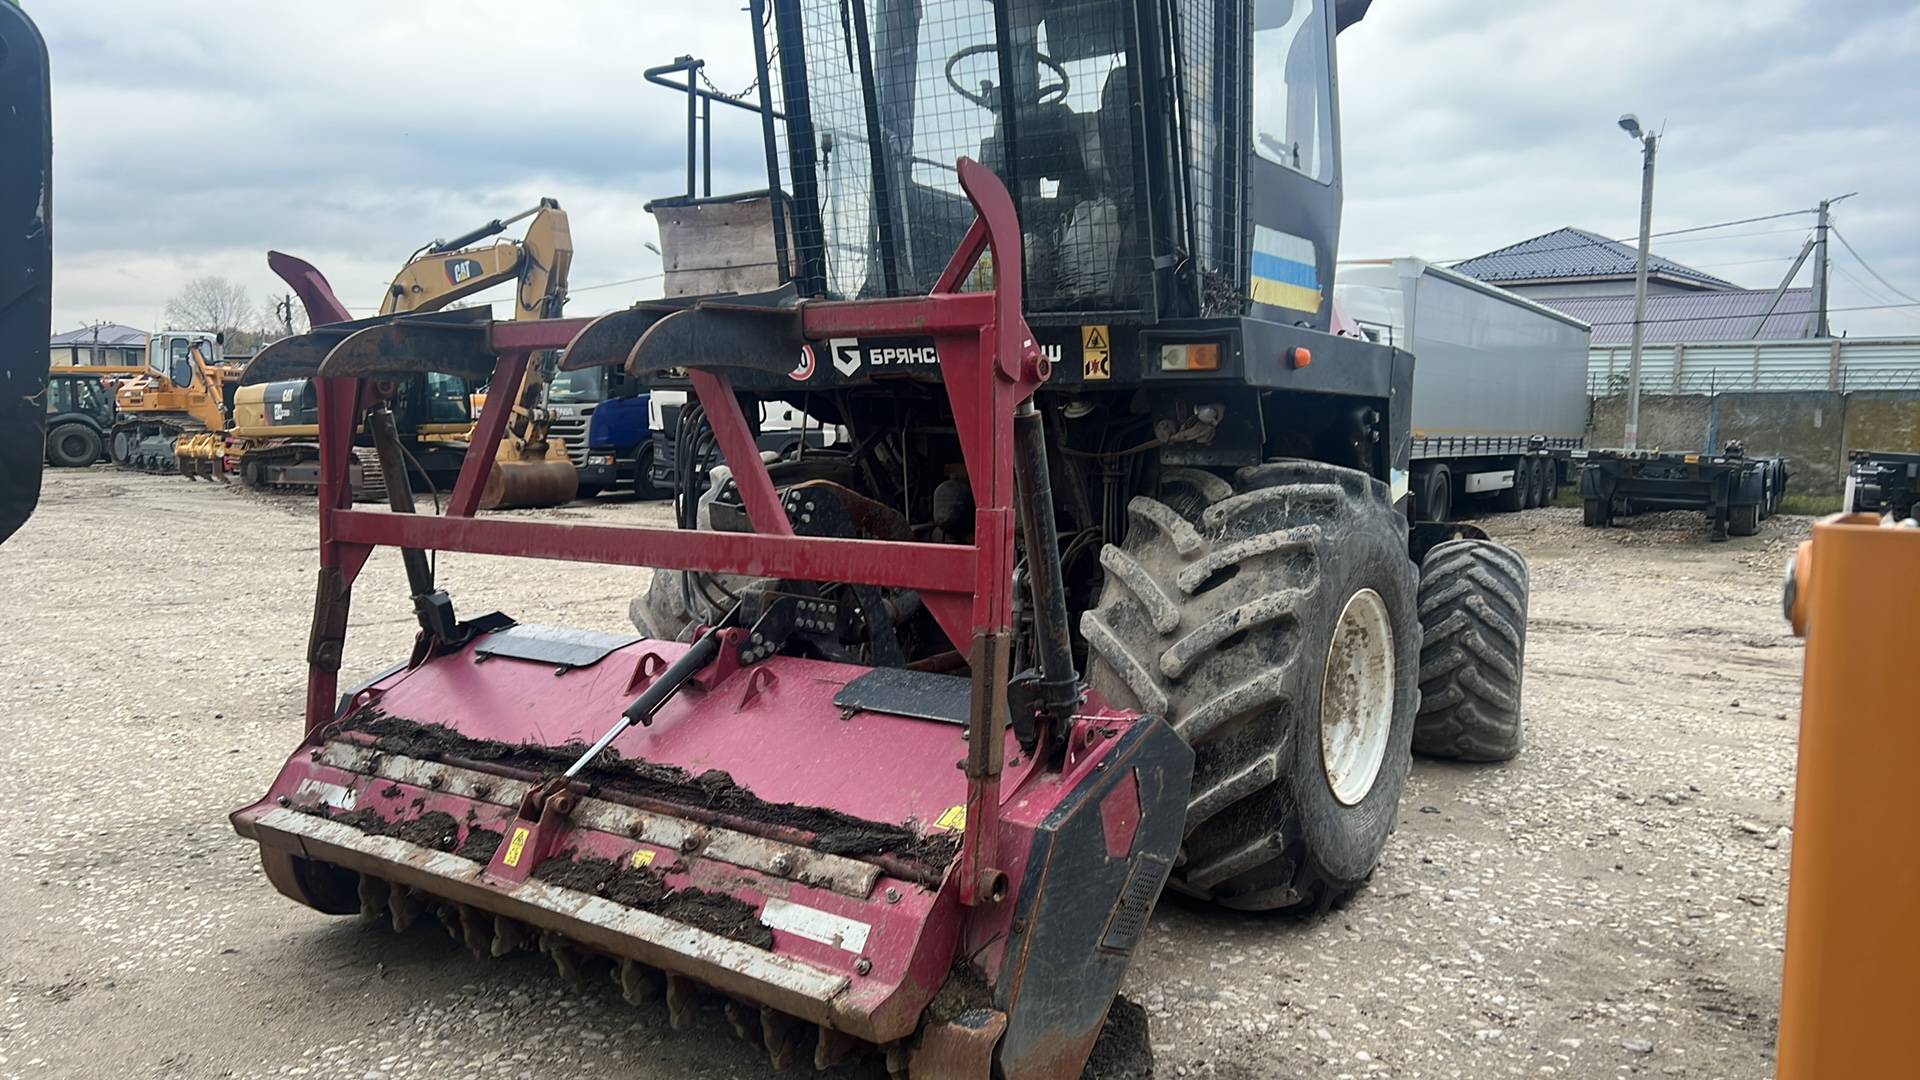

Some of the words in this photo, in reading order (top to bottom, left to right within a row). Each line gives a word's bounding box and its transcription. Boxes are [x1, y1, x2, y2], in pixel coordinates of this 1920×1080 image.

[454, 260, 470, 283] CAT
[870, 346, 941, 366] БРЯНС
[282, 388, 294, 402] CAT
